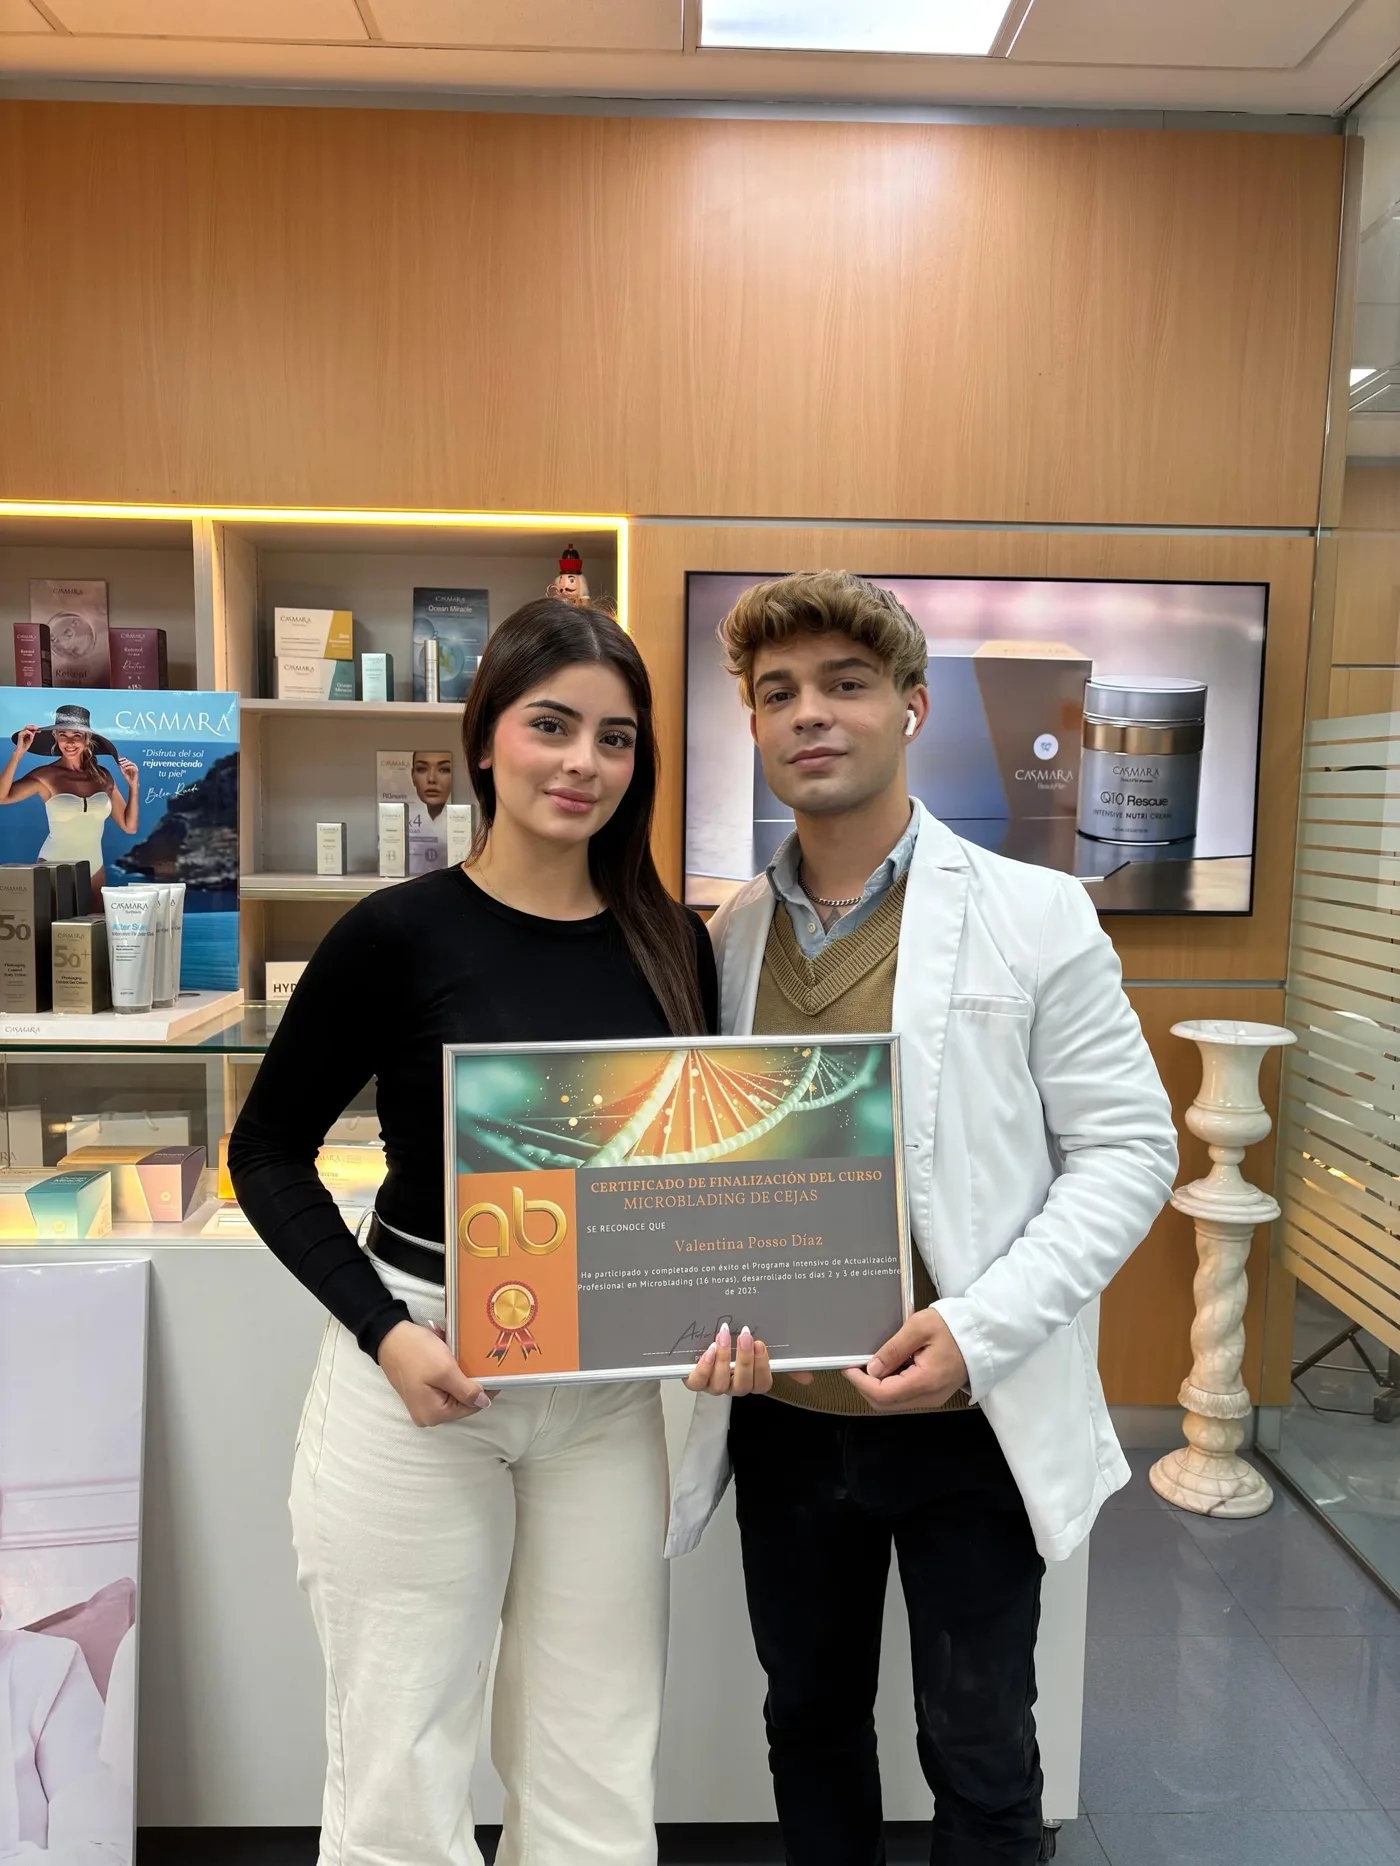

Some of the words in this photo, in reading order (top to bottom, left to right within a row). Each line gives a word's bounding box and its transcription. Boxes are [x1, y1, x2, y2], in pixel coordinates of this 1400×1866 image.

[428, 604, 449, 612] Ocean
[450, 605, 473, 613] Miracle
[280, 615, 311, 624] CASMARA
[284, 664, 314, 672] CASMARA
[116, 711, 230, 737] CASMARA
[178, 749, 190, 758] del
[191, 750, 203, 758] sol
[142, 760, 203, 769] rejuveneciendo
[1015, 769, 1073, 783] CASMARA
[1112, 766, 1160, 778] CASMARA
[1100, 791, 1124, 806] Q10
[1126, 795, 1168, 807] Rescue
[1092, 809, 1122, 819] INTENSIVE
[1126, 812, 1148, 820] NUTRI
[1150, 812, 1172, 820] CREAM
[111, 902, 148, 910] CASMARA
[591, 1178, 684, 1193] CERTIFICADO
[688, 1177, 706, 1188] DE
[710, 1171, 806, 1188] FINALIZACIÓN
[810, 1172, 836, 1184] DEL
[838, 1170, 882, 1182] CURSO
[624, 1192, 745, 1210] MICROBLADING
[750, 1191, 770, 1204] DE
[774, 1189, 818, 1205] CEJAS
[586, 1225, 597, 1234] SE
[600, 1222, 645, 1233] RECONOCE
[648, 1222, 666, 1232] QUE
[675, 1237, 744, 1253] Valentina
[748, 1236, 788, 1249] Posso
[791, 1233, 824, 1247] Díaz
[581, 1271, 592, 1280] Ha
[594, 1268, 641, 1282] participado
[652, 1266, 699, 1278] completado
[702, 1264, 716, 1272] con
[718, 1264, 739, 1272] éxito
[742, 1262, 750, 1270] el
[752, 1262, 790, 1272] Programa
[793, 1259, 829, 1268] Intensivo
[832, 1258, 842, 1266] de
[844, 1256, 897, 1265] Actualización
[578, 1282, 624, 1292] Profesional
[640, 1278, 693, 1289] Microblading
[696, 1276, 709, 1286] (16
[742, 1272, 792, 1282] desarrollado
[794, 1272, 806, 1280] los
[828, 1270, 833, 1278] 2
[850, 1268, 860, 1276] de
[862, 1267, 901, 1276] diciembre
[724, 1288, 735, 1296] de
[738, 1286, 760, 1295] 2025.
